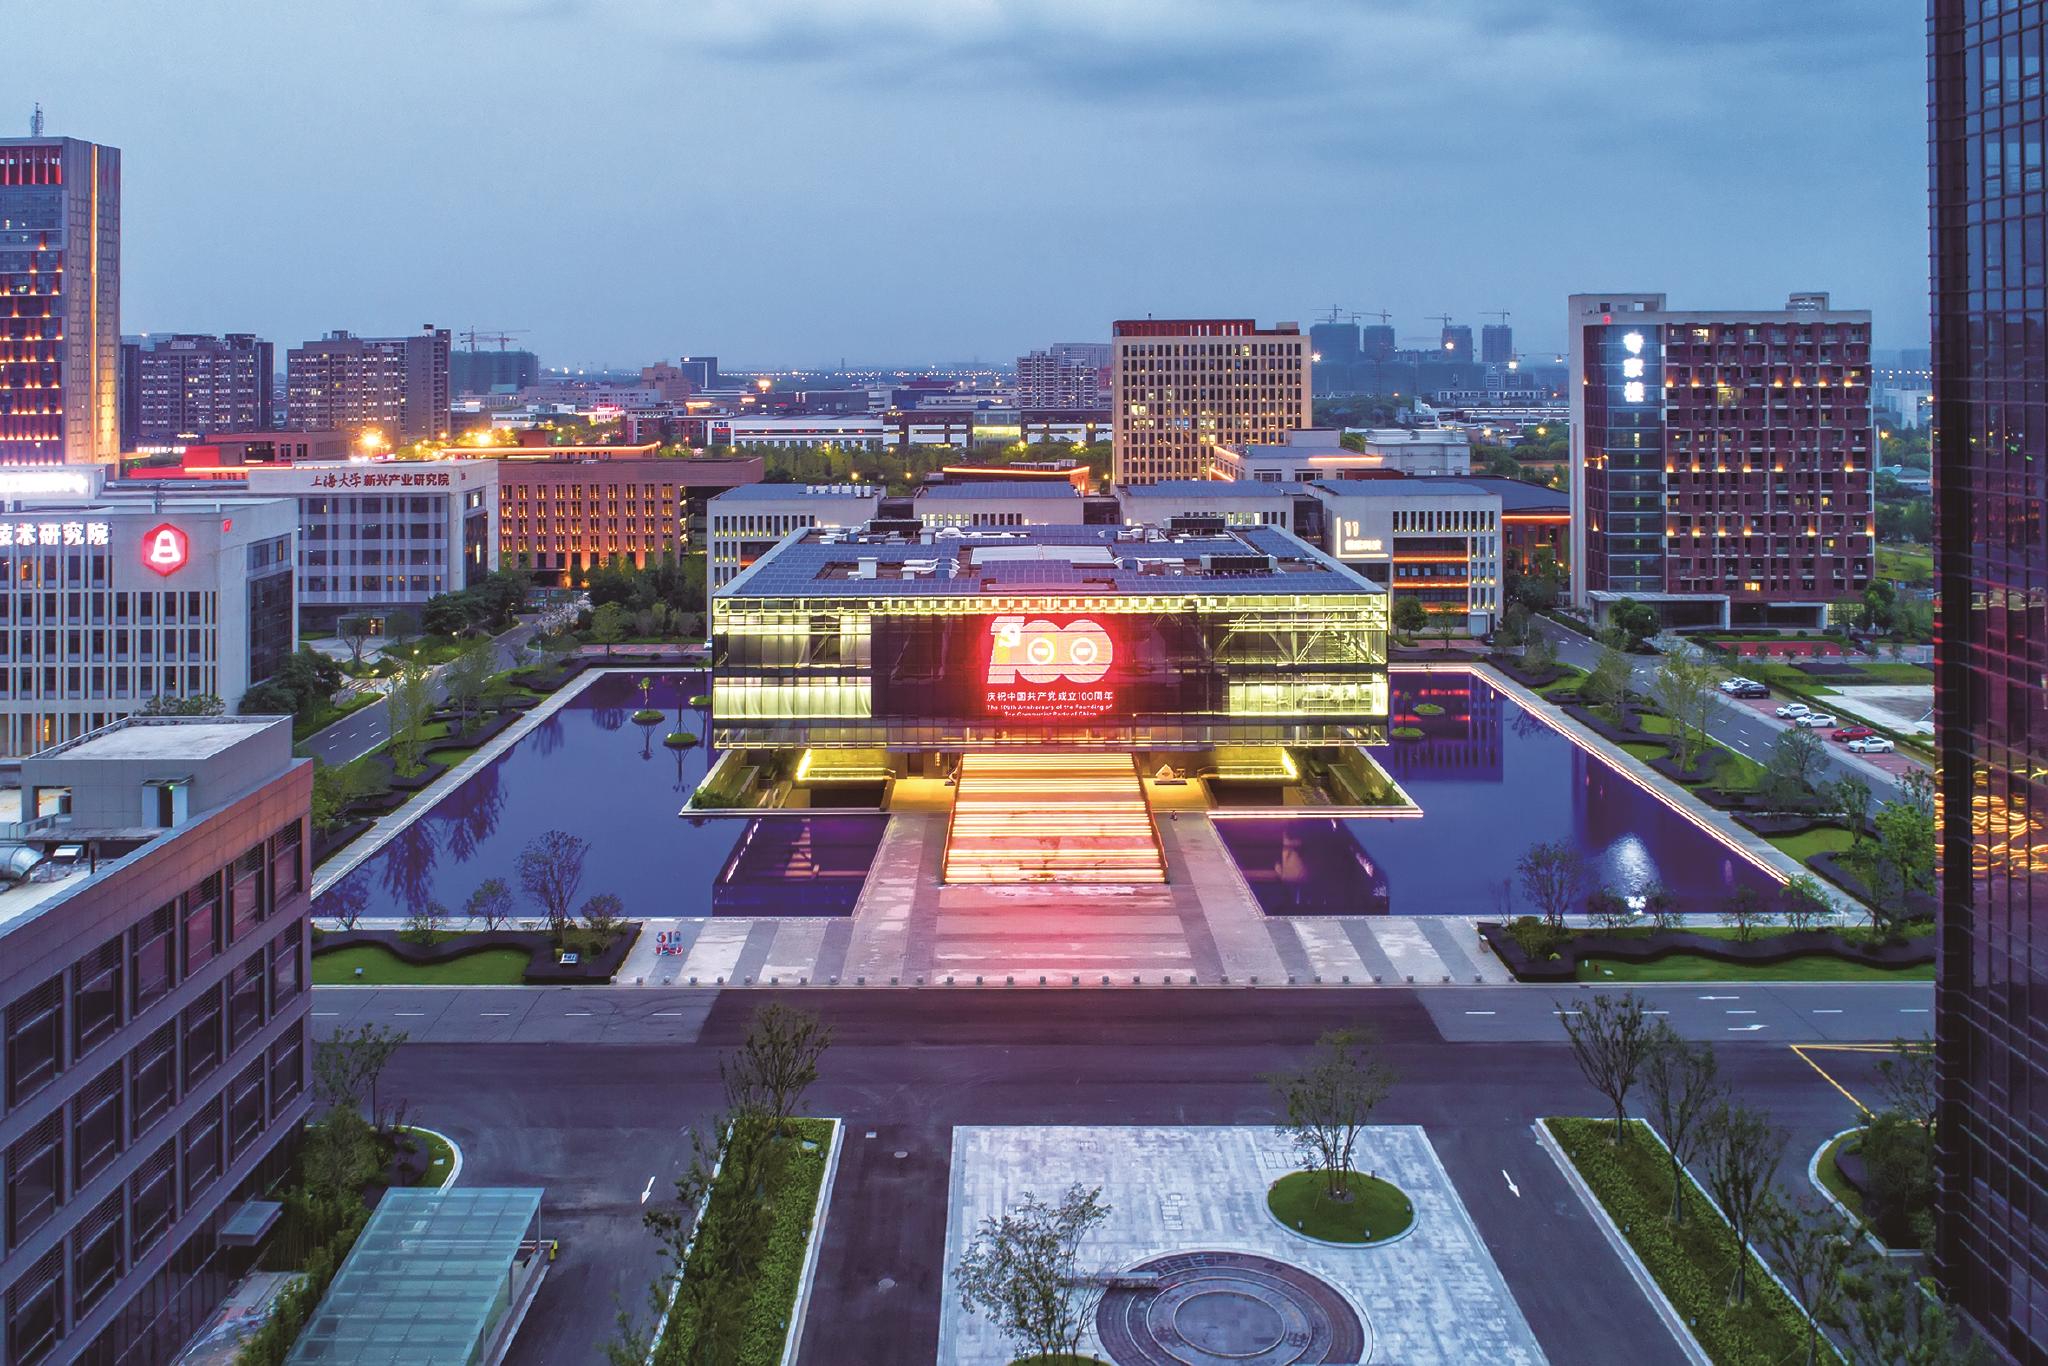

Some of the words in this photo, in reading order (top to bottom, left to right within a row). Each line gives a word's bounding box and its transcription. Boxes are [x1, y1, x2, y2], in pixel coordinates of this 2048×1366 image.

[310, 472, 450, 488] 上海大学新兴产业研究院
[987, 616, 1113, 684] 100
[987, 691, 1113, 702] 庆祝中国共产党成立100周年
